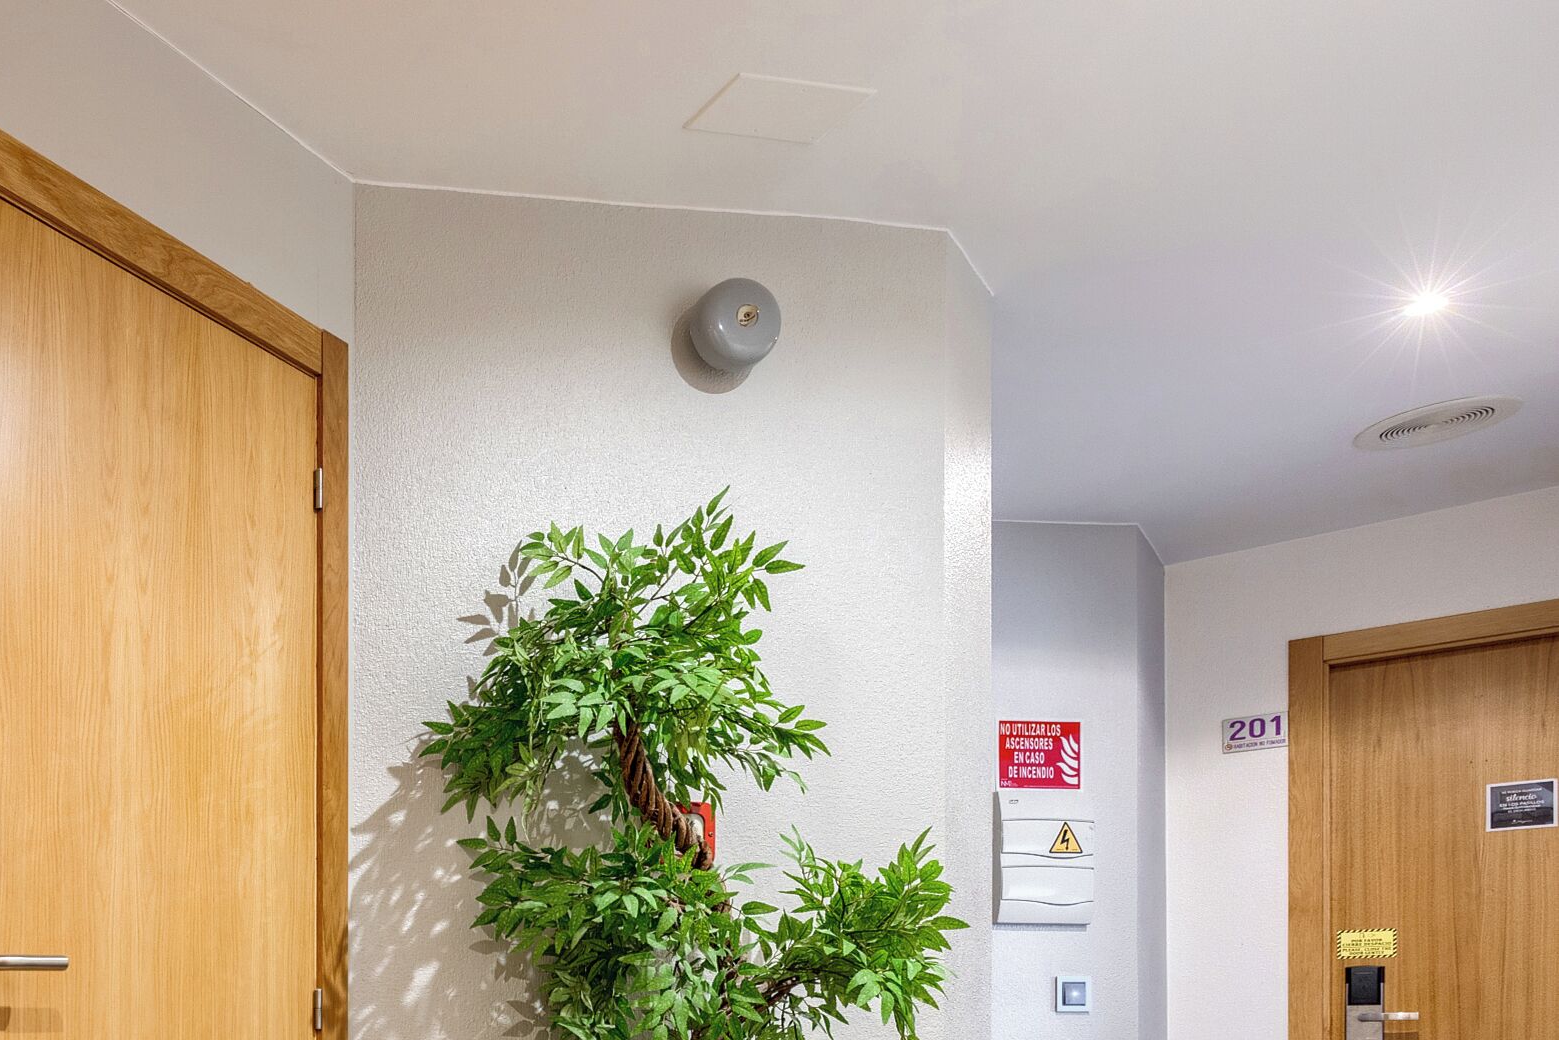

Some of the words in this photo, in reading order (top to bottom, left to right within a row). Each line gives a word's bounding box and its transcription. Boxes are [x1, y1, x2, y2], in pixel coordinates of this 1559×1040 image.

[1000, 723, 1011, 736] NO
[1012, 723, 1046, 736] UTILIZAR
[1047, 724, 1061, 737] LOS
[1229, 715, 1281, 741] 201
[1005, 737, 1053, 750] ASCENSORES
[1014, 751, 1024, 764] EN
[1025, 751, 1045, 764] CASO
[1008, 766, 1018, 778] DE
[1019, 766, 1054, 779] INCENDIO
[1506, 793, 1537, 802] silencio
